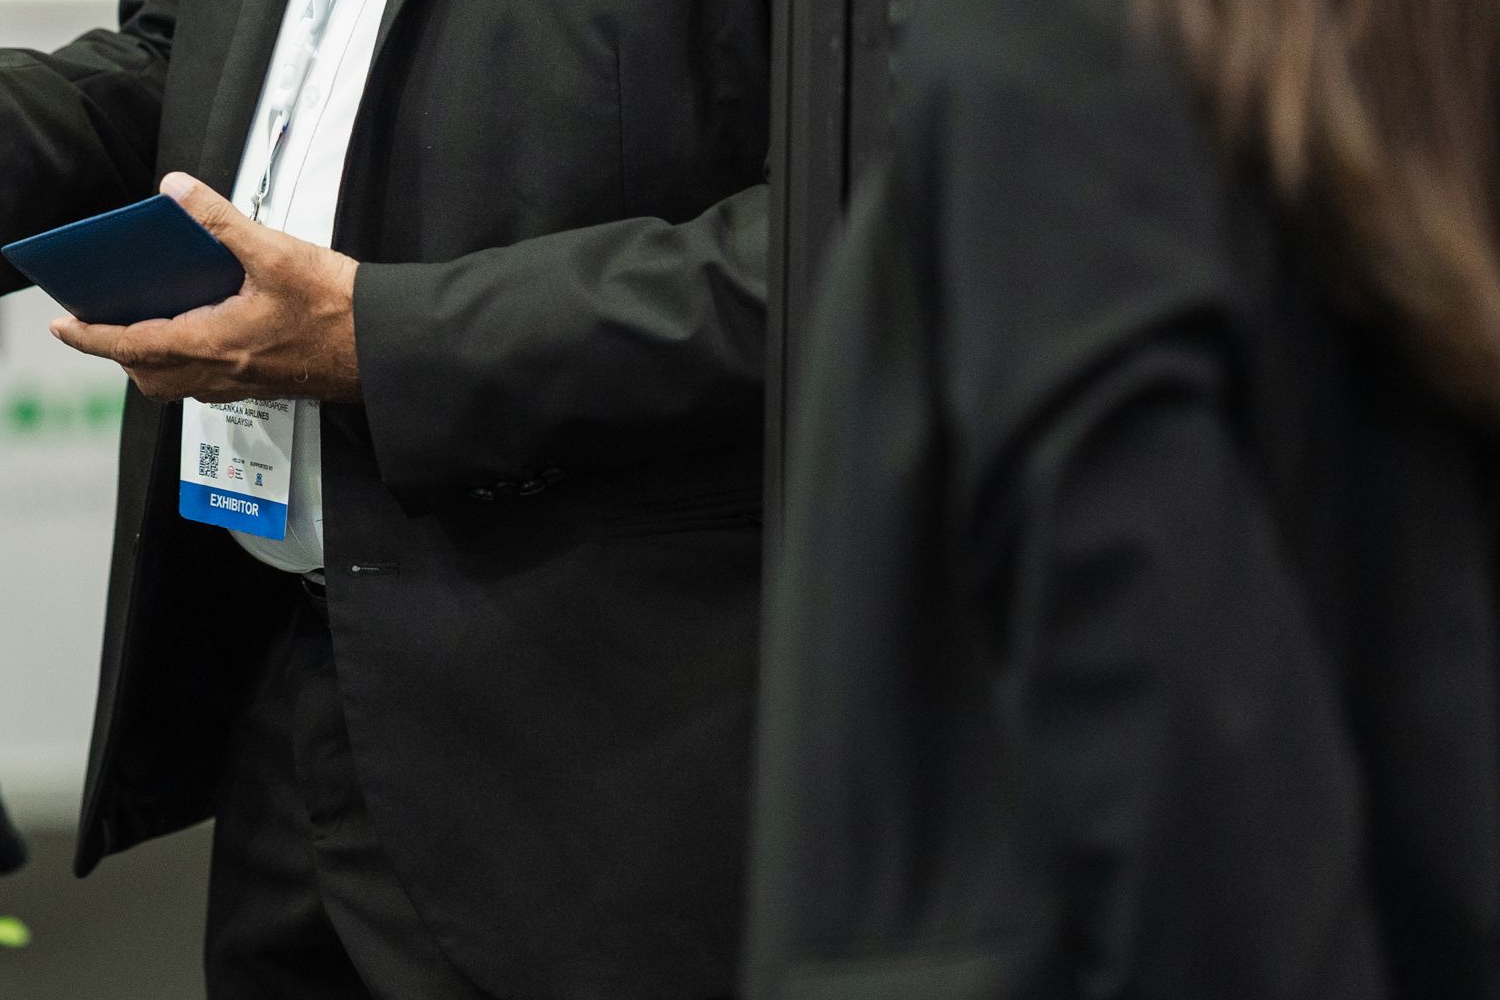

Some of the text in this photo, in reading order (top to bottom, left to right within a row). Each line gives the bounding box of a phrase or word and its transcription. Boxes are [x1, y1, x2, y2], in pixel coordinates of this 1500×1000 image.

[226, 415, 253, 427] MALAYSIA
[245, 408, 270, 421] AIRLINES
[210, 493, 259, 516] EXHIBITOR
